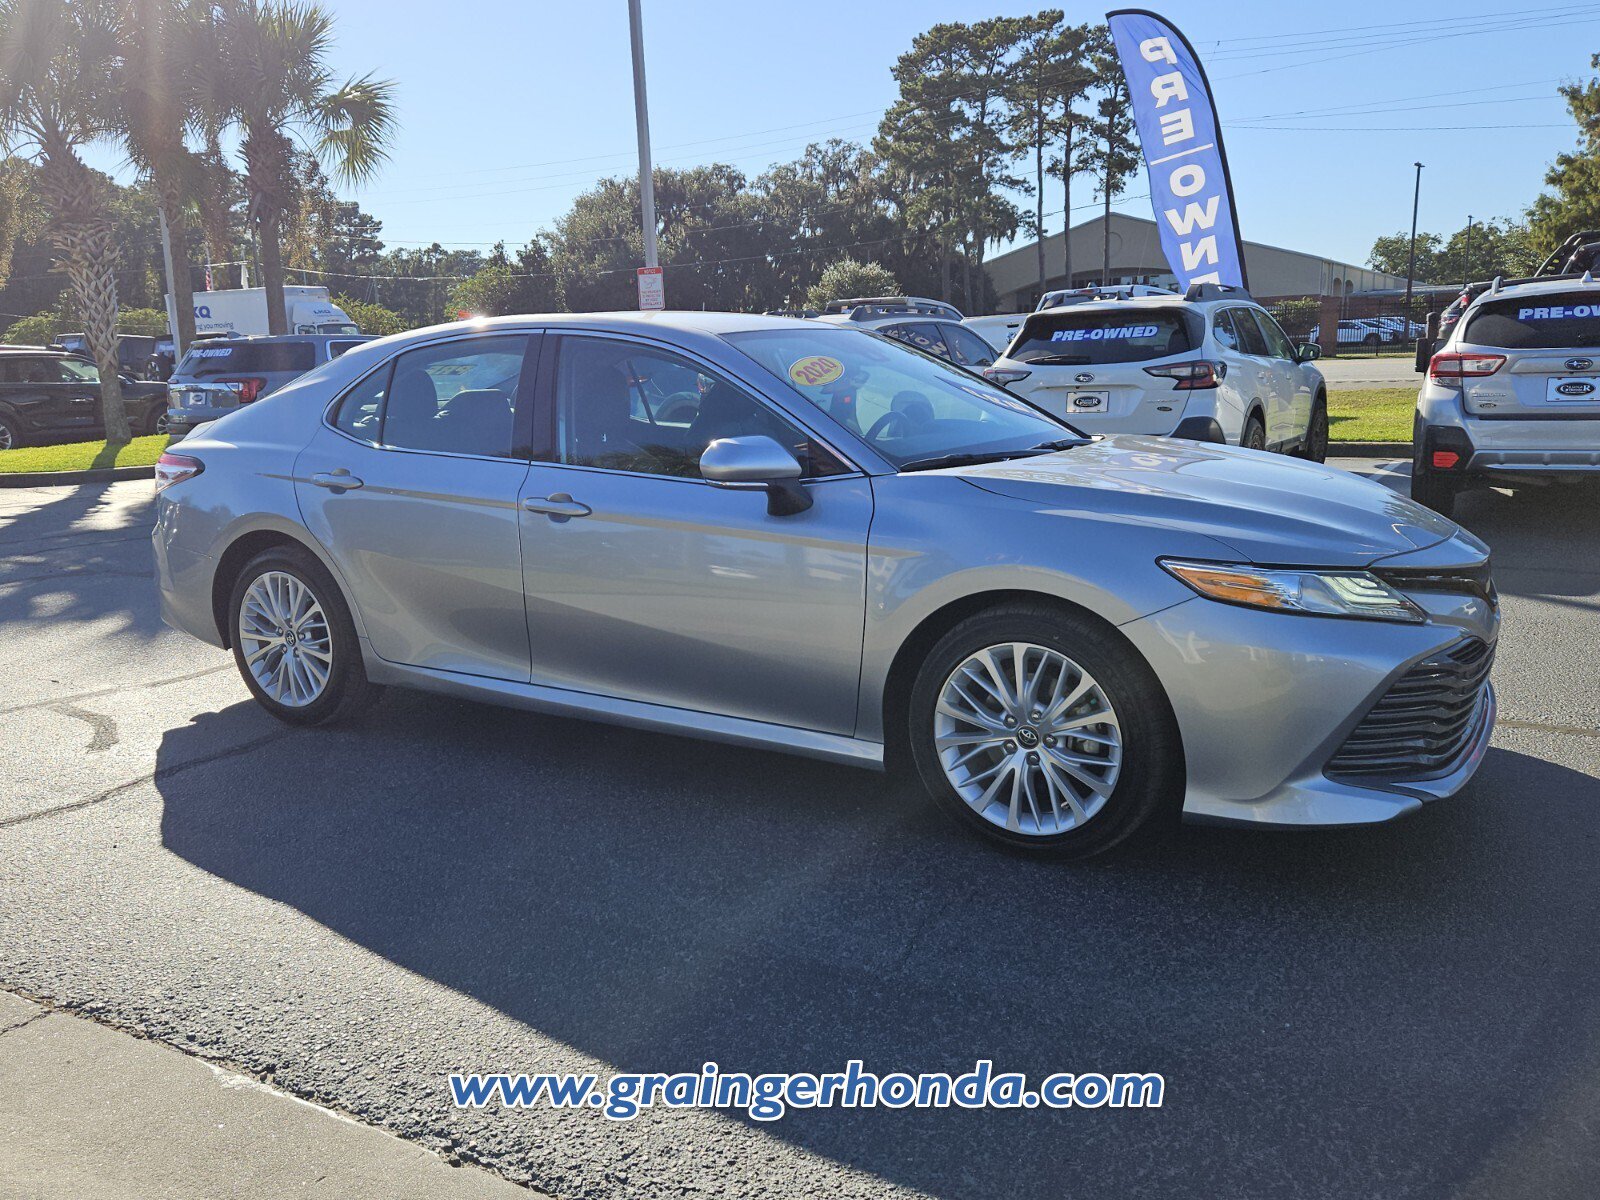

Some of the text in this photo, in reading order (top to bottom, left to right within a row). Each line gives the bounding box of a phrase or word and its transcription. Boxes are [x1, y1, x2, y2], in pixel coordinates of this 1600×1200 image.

[193, 305, 212, 318] KQ
[214, 321, 234, 330] moving
[1051, 326, 1158, 342] PRE-OWNED
[189, 348, 233, 358] PRE-OWNED
[795, 357, 838, 384] 2020
